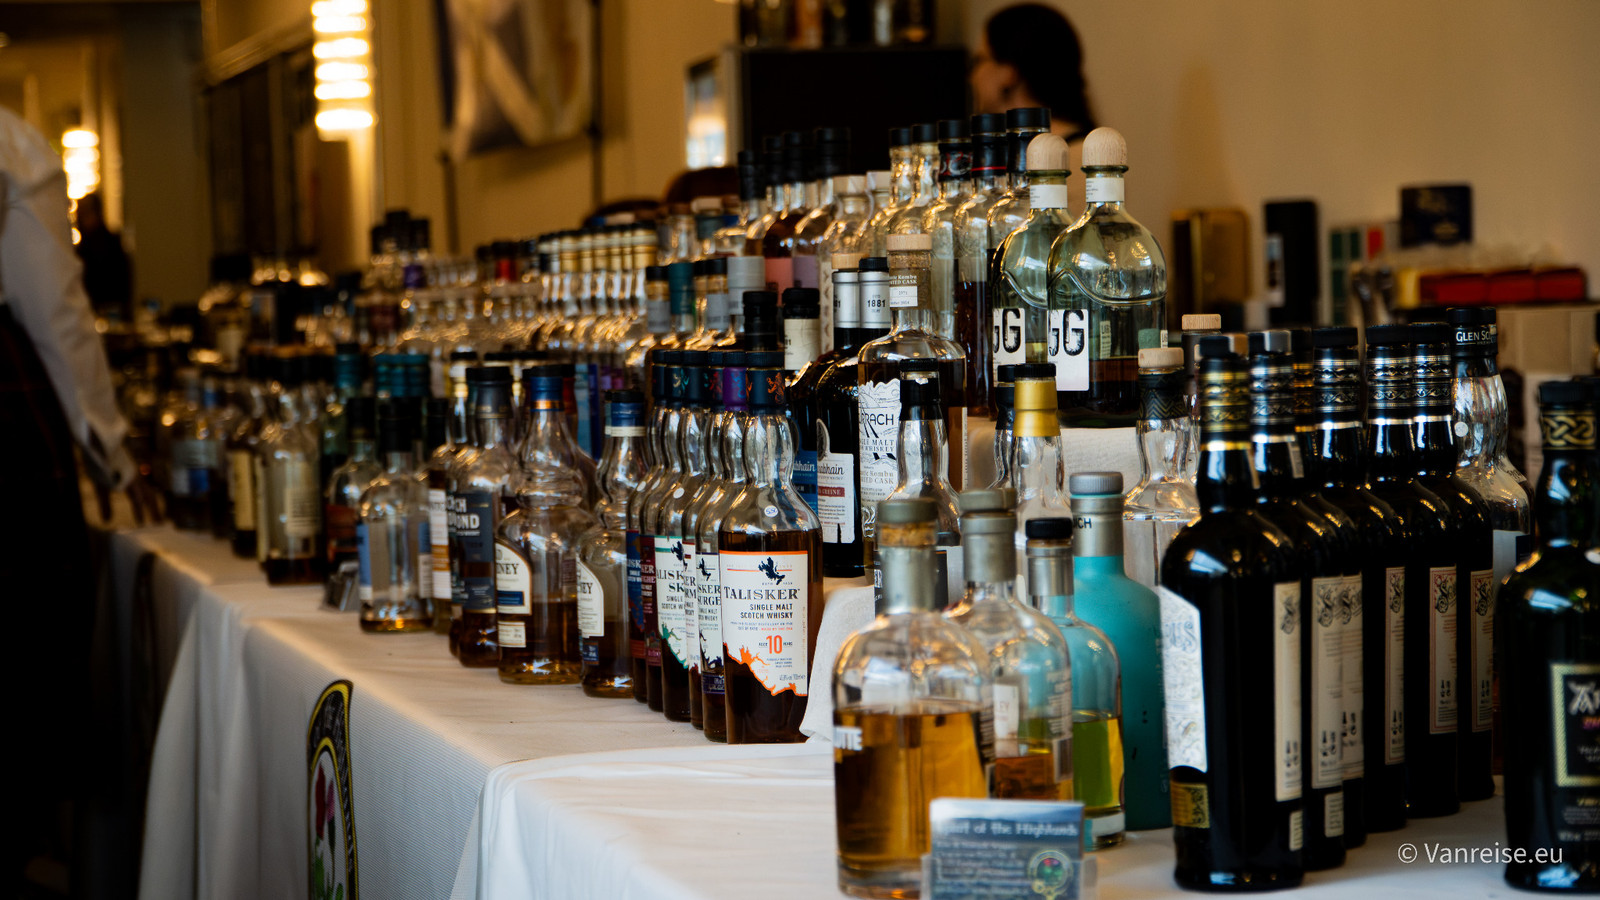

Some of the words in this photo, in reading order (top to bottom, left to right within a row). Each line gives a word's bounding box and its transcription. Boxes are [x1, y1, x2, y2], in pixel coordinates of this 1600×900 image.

[867, 299, 886, 308] 1881
[1455, 331, 1480, 342] GLEN
[723, 586, 800, 600] TALISKER
[740, 611, 764, 619] SCOTCH
[766, 611, 794, 619] WHISKY
[766, 635, 783, 654] 10
